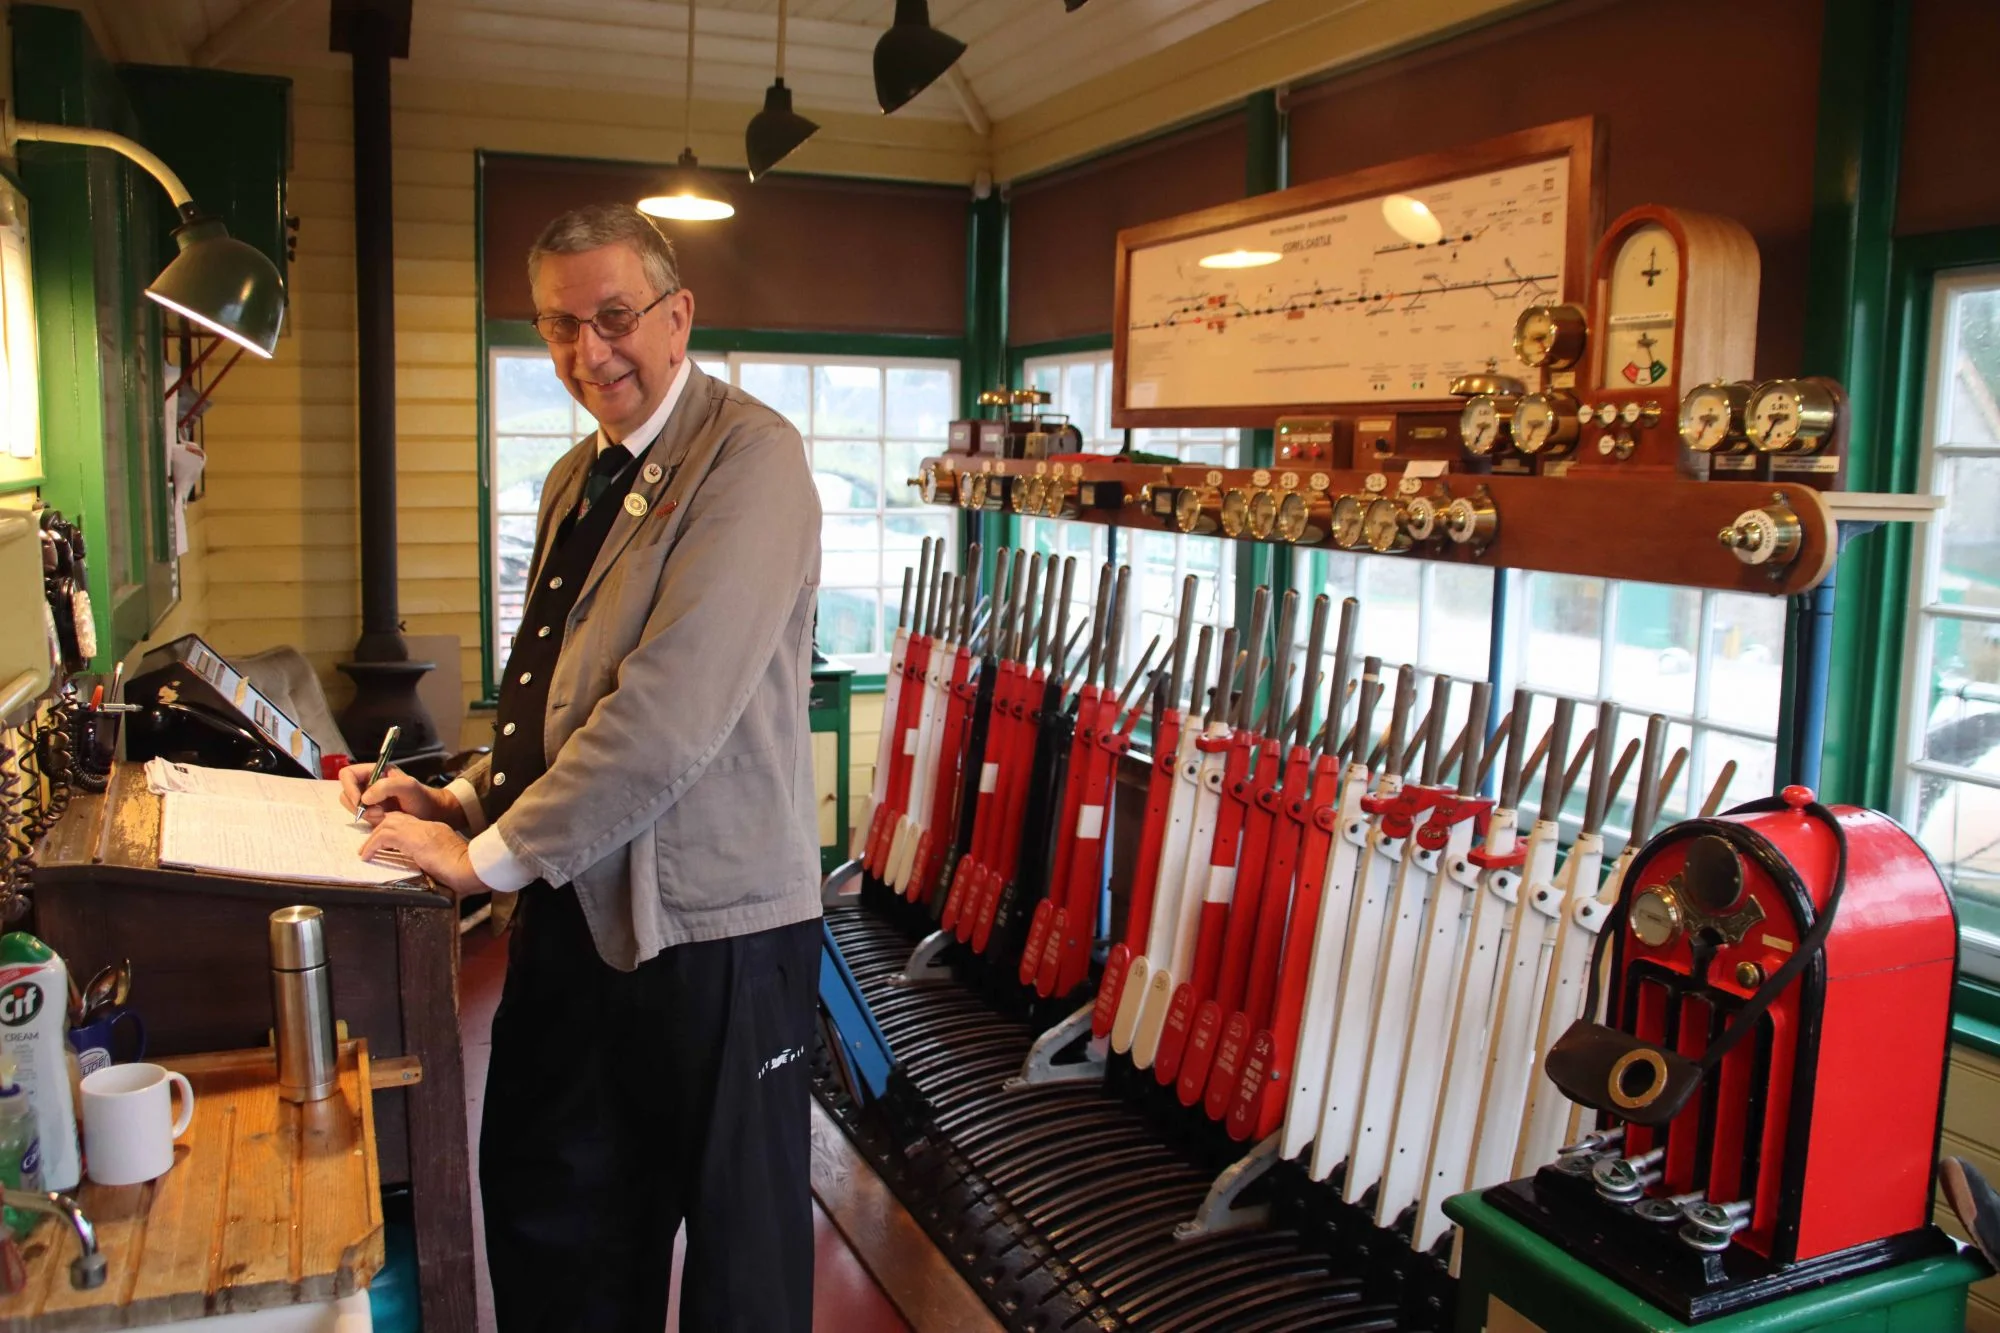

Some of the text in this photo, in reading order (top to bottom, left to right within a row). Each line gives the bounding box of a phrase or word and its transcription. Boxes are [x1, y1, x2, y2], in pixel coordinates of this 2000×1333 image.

[0, 986, 37, 1021] Cif
[4, 1031, 39, 1041] CREAM
[1255, 1038, 1269, 1056] 24
